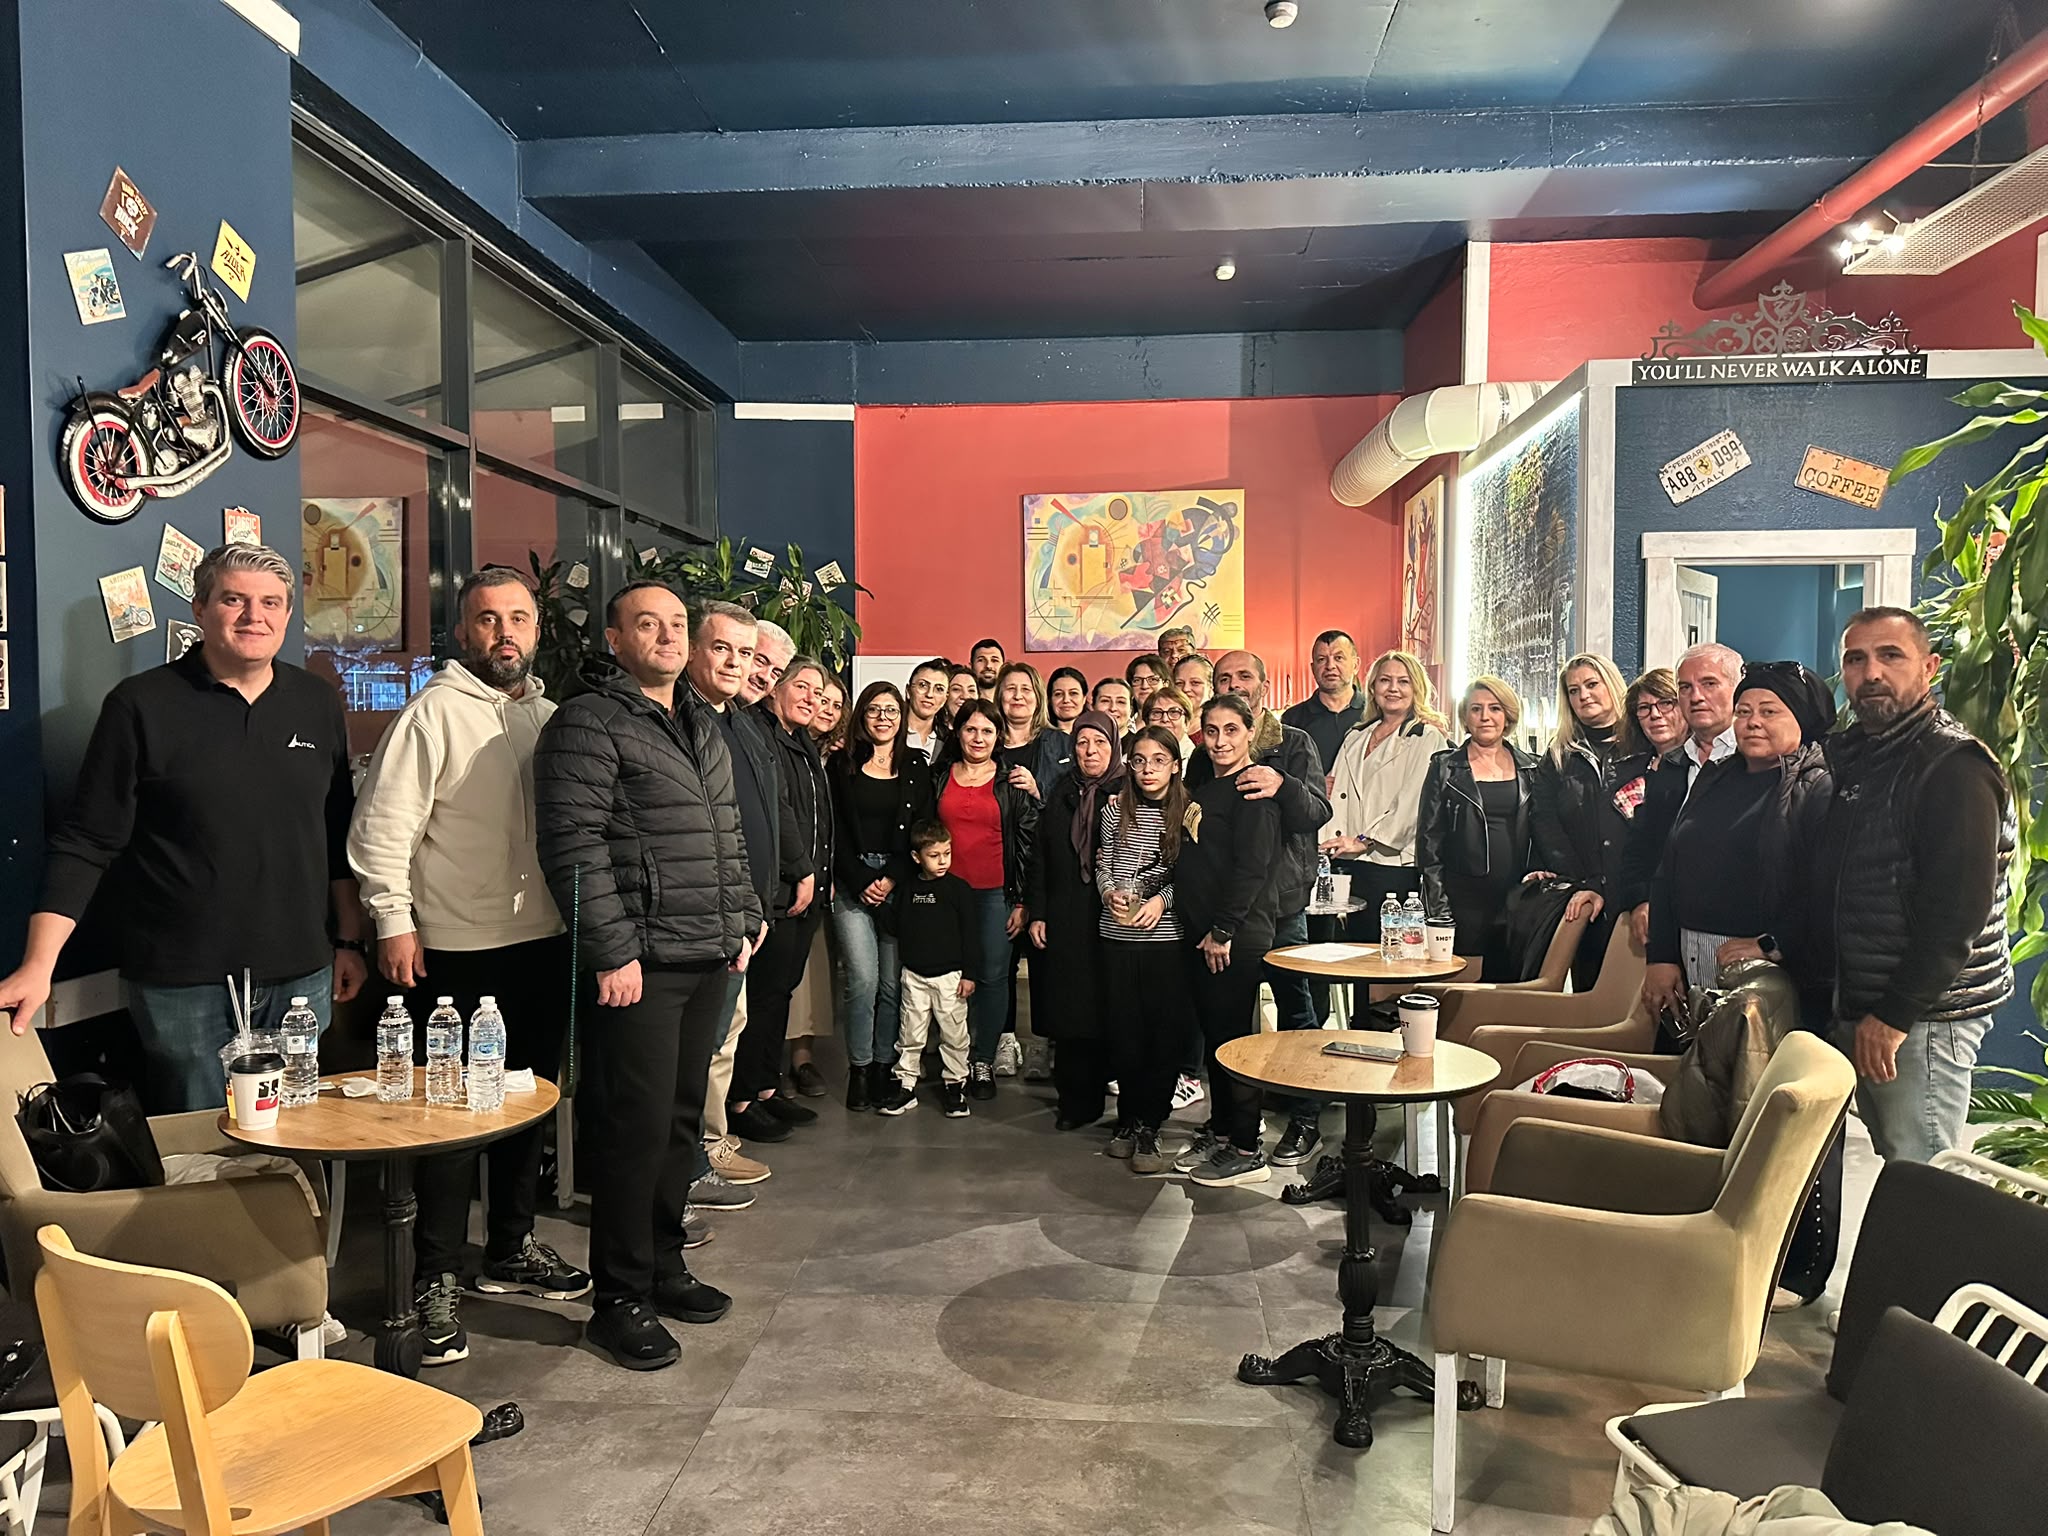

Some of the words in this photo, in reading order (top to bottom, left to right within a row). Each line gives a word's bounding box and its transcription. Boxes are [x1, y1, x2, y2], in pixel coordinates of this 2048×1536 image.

[1637, 364, 1706, 381] YOU'LL
[1710, 362, 1779, 379] NEVER
[1781, 360, 1845, 377] WALK
[1848, 358, 1922, 375] ALONE
[1667, 465, 1697, 494] A88
[1711, 440, 1742, 467] D99
[1672, 448, 1705, 469] FERRARI
[1695, 469, 1726, 490] ITALY
[1804, 467, 1880, 503] COFFEE
[228, 514, 257, 530] CLASSIC
[109, 571, 137, 584] ARIZONA
